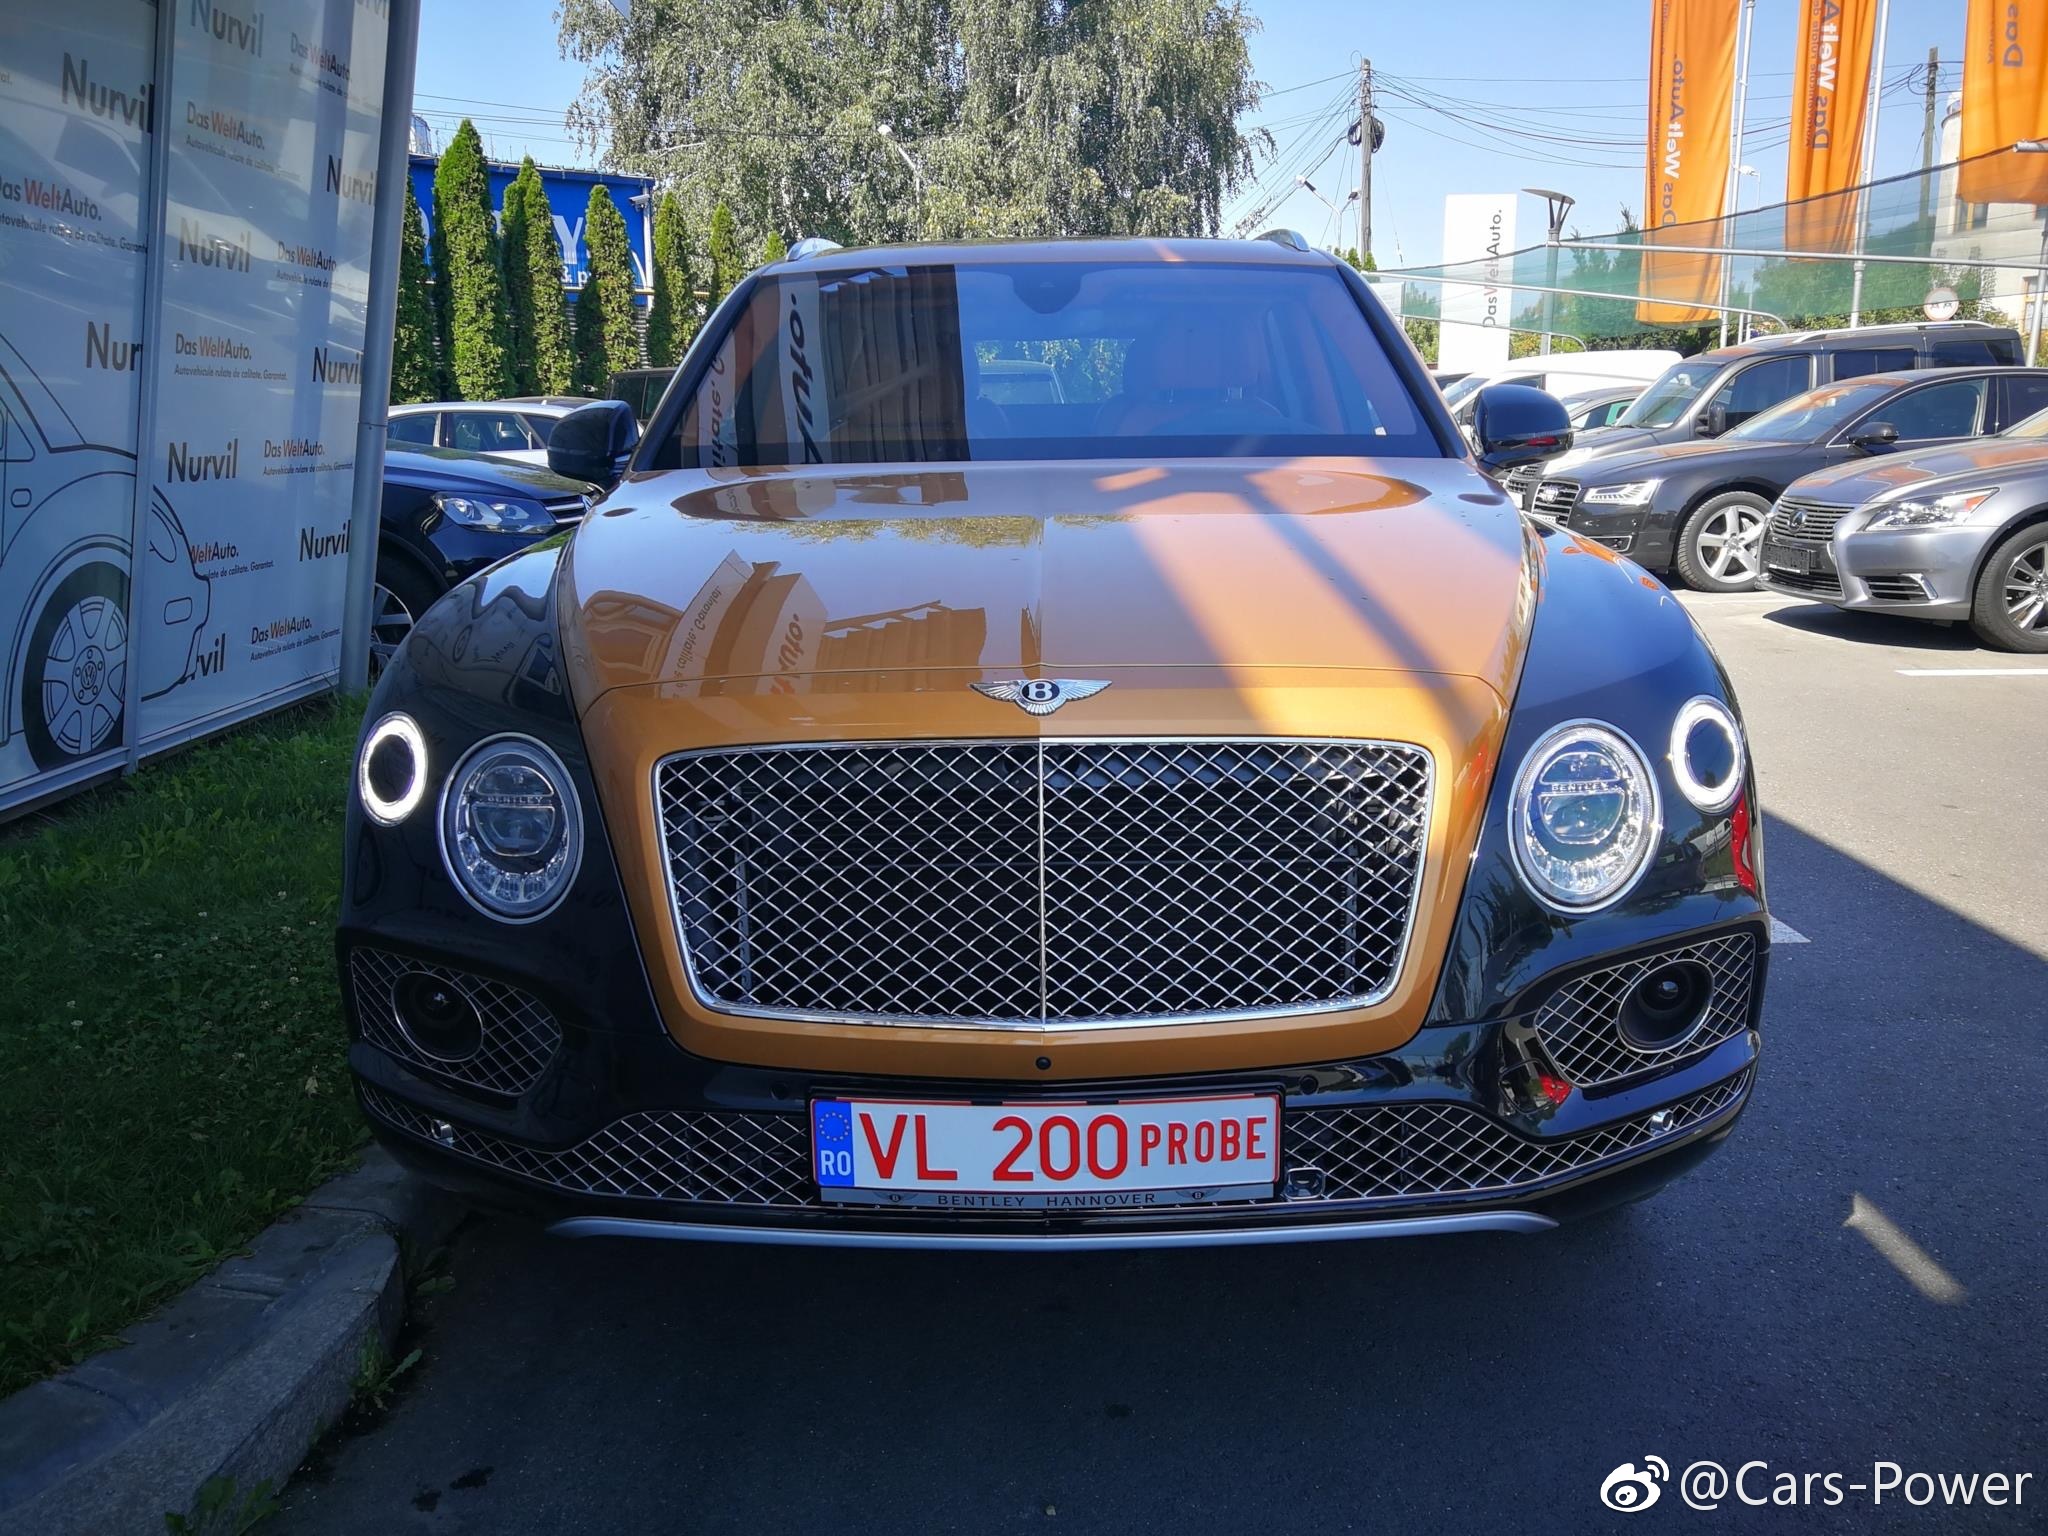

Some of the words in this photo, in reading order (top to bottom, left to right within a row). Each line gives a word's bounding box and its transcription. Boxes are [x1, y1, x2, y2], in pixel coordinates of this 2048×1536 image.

[191, 0, 264, 58] Nurvil
[62, 52, 155, 134] Nurvil
[187, 101, 209, 130] Das
[0, 176, 21, 202] as
[179, 218, 251, 273] Nurvil
[175, 333, 197, 356] Das
[199, 336, 252, 360] WeltAuto.
[168, 438, 238, 483] Nurvil
[264, 439, 282, 458] Das
[300, 520, 351, 562] Nurvil
[252, 627, 269, 645] Das
[859, 1113, 958, 1181] VL
[992, 1114, 1128, 1181] 200
[1141, 1117, 1268, 1167] PROBE
[820, 1150, 852, 1176] RO
[938, 1195, 1025, 1207] BENTLEY
[1046, 1193, 1156, 1207] HANNOVER
